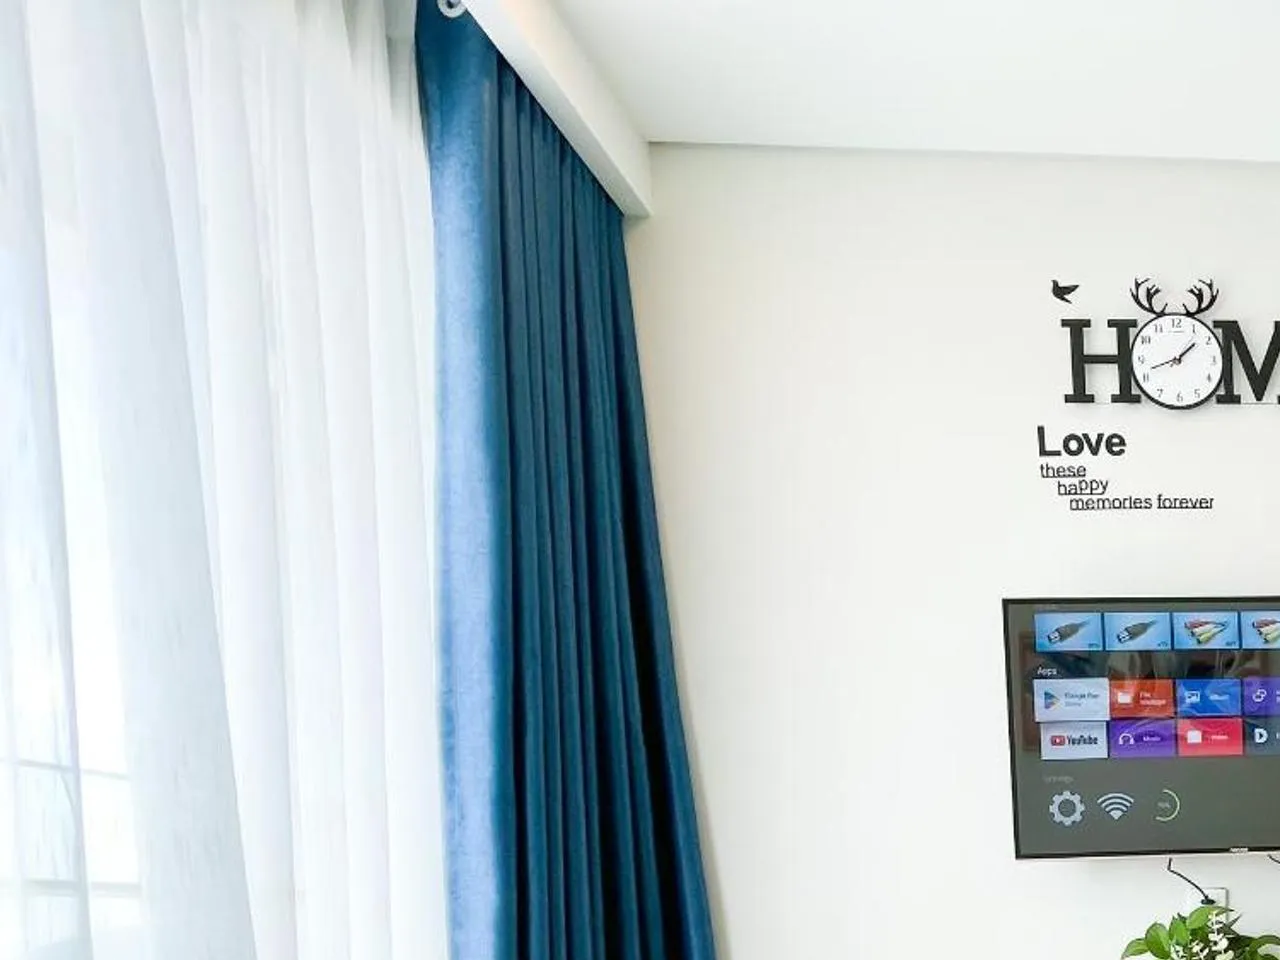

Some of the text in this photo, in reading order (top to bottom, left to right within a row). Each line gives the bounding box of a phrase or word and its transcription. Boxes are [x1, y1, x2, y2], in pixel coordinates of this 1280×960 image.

[1171, 318, 1182, 329] 12
[1037, 425, 1127, 457] Love
[1040, 463, 1087, 478] these
[1057, 478, 1109, 496] happy
[1069, 494, 1214, 511] memories forever
[1037, 666, 1057, 677] Apps
[1066, 734, 1099, 746] YouTube
